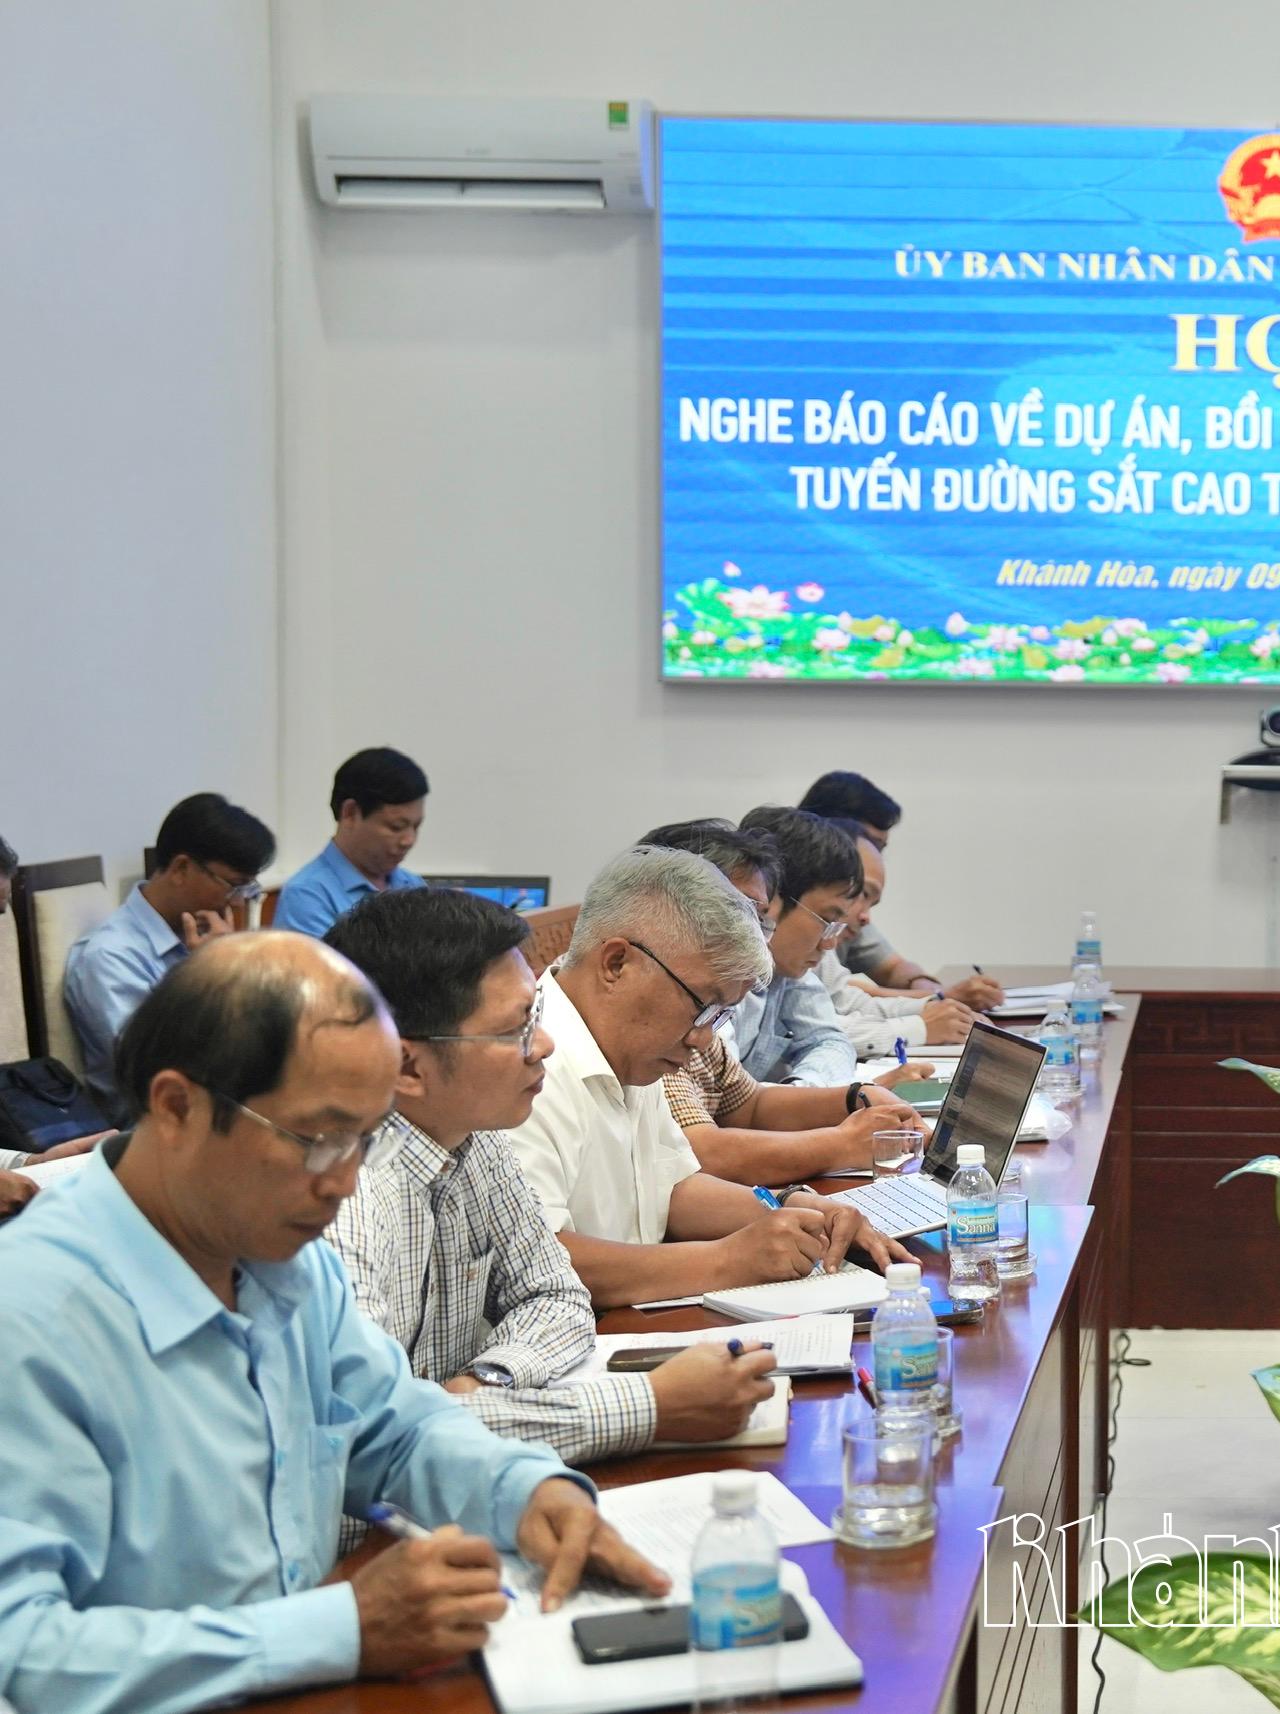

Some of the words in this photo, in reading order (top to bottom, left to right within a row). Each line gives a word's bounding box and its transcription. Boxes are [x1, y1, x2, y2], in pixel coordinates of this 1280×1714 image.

[964, 252, 1044, 278] BAN
[1060, 247, 1174, 280] NHÂN
[1190, 248, 1273, 282] DÂN
[681, 398, 793, 443] NGHE
[805, 391, 885, 444] BÁO
[900, 392, 978, 445] CÁO
[991, 388, 1043, 446] VỀ
[1055, 400, 1115, 454] DỰ
[1123, 395, 1191, 454] ÁN,
[1206, 390, 1273, 449] BỒI
[790, 452, 920, 510] TUYẾN
[932, 459, 1075, 512] ĐƯỜNG
[1088, 453, 1161, 513] SẮT
[1172, 472, 1250, 515] CAO
[997, 560, 1091, 586] Khánh
[1168, 562, 1242, 591] ngày
[957, 1216, 996, 1233] Sanna
